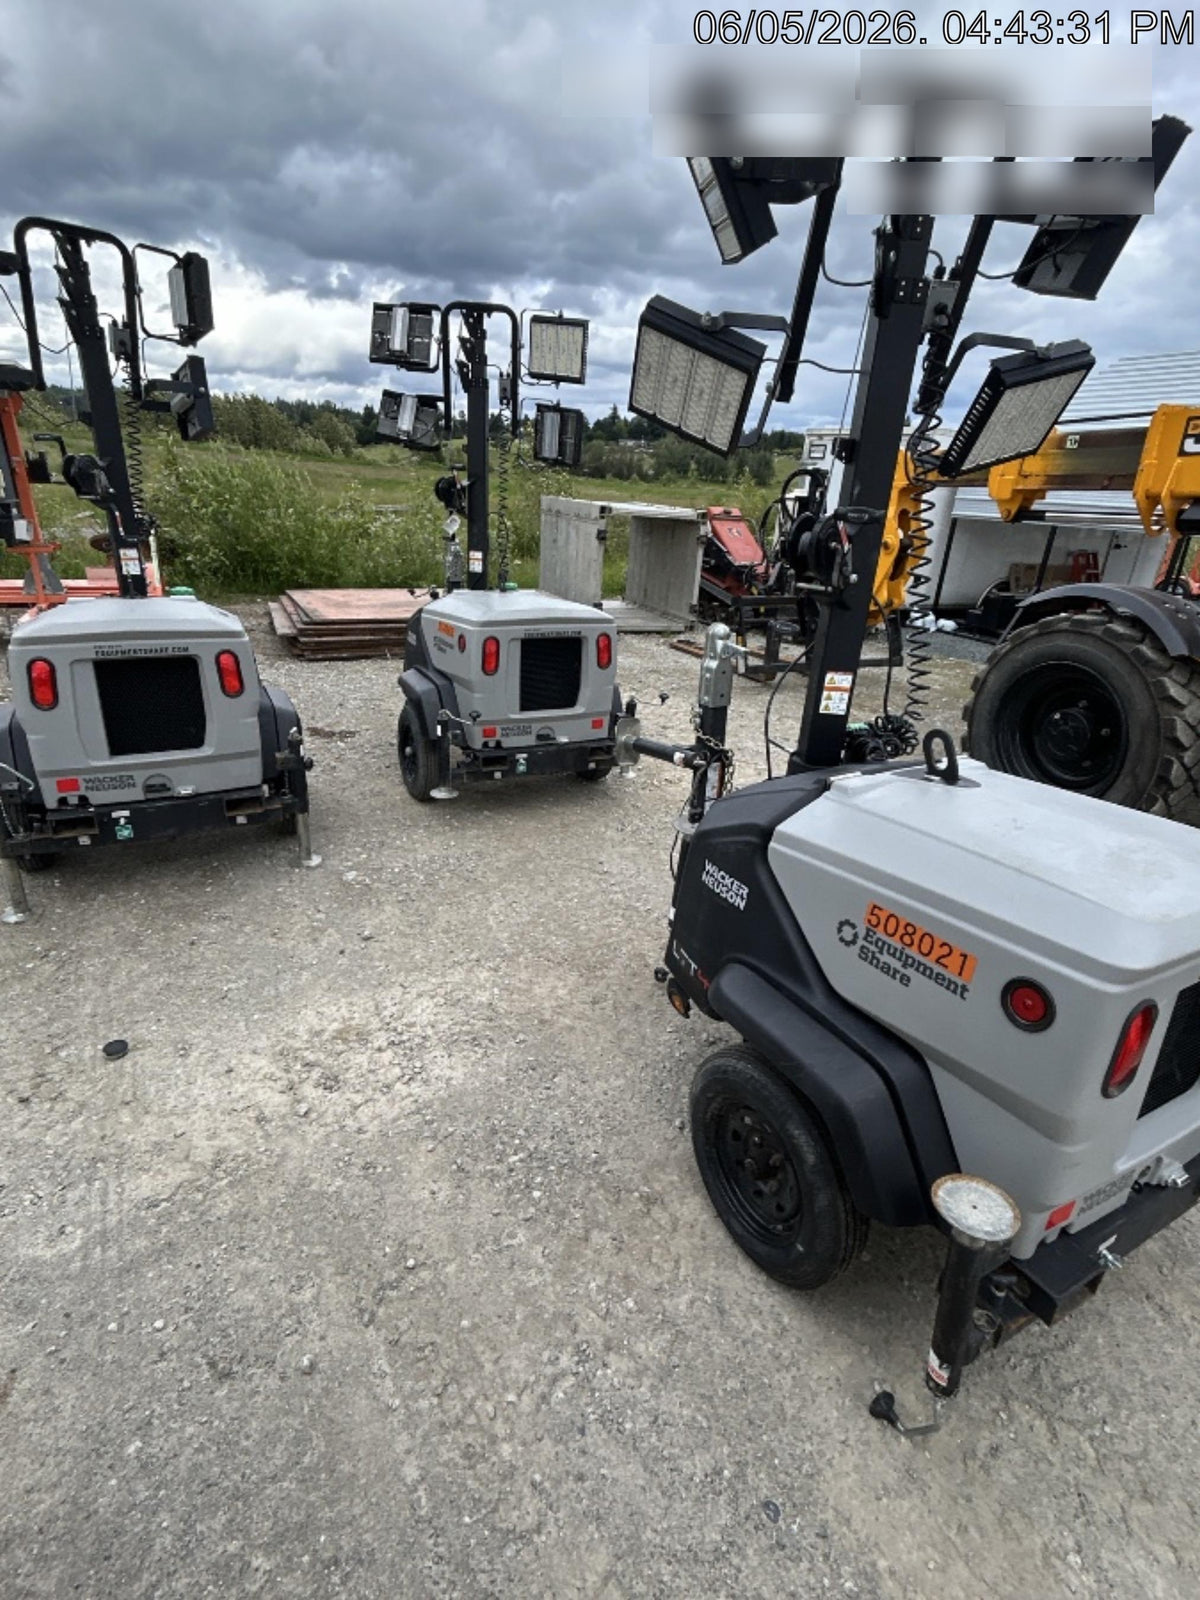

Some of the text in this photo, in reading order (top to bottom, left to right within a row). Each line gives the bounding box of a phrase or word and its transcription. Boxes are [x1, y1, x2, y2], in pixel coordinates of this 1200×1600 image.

[702, 870, 746, 911] NEUSON
[704, 858, 749, 899] WACKER
[862, 917, 971, 1001] Equipment
[866, 903, 969, 978] 508021
[857, 944, 912, 988] Share
